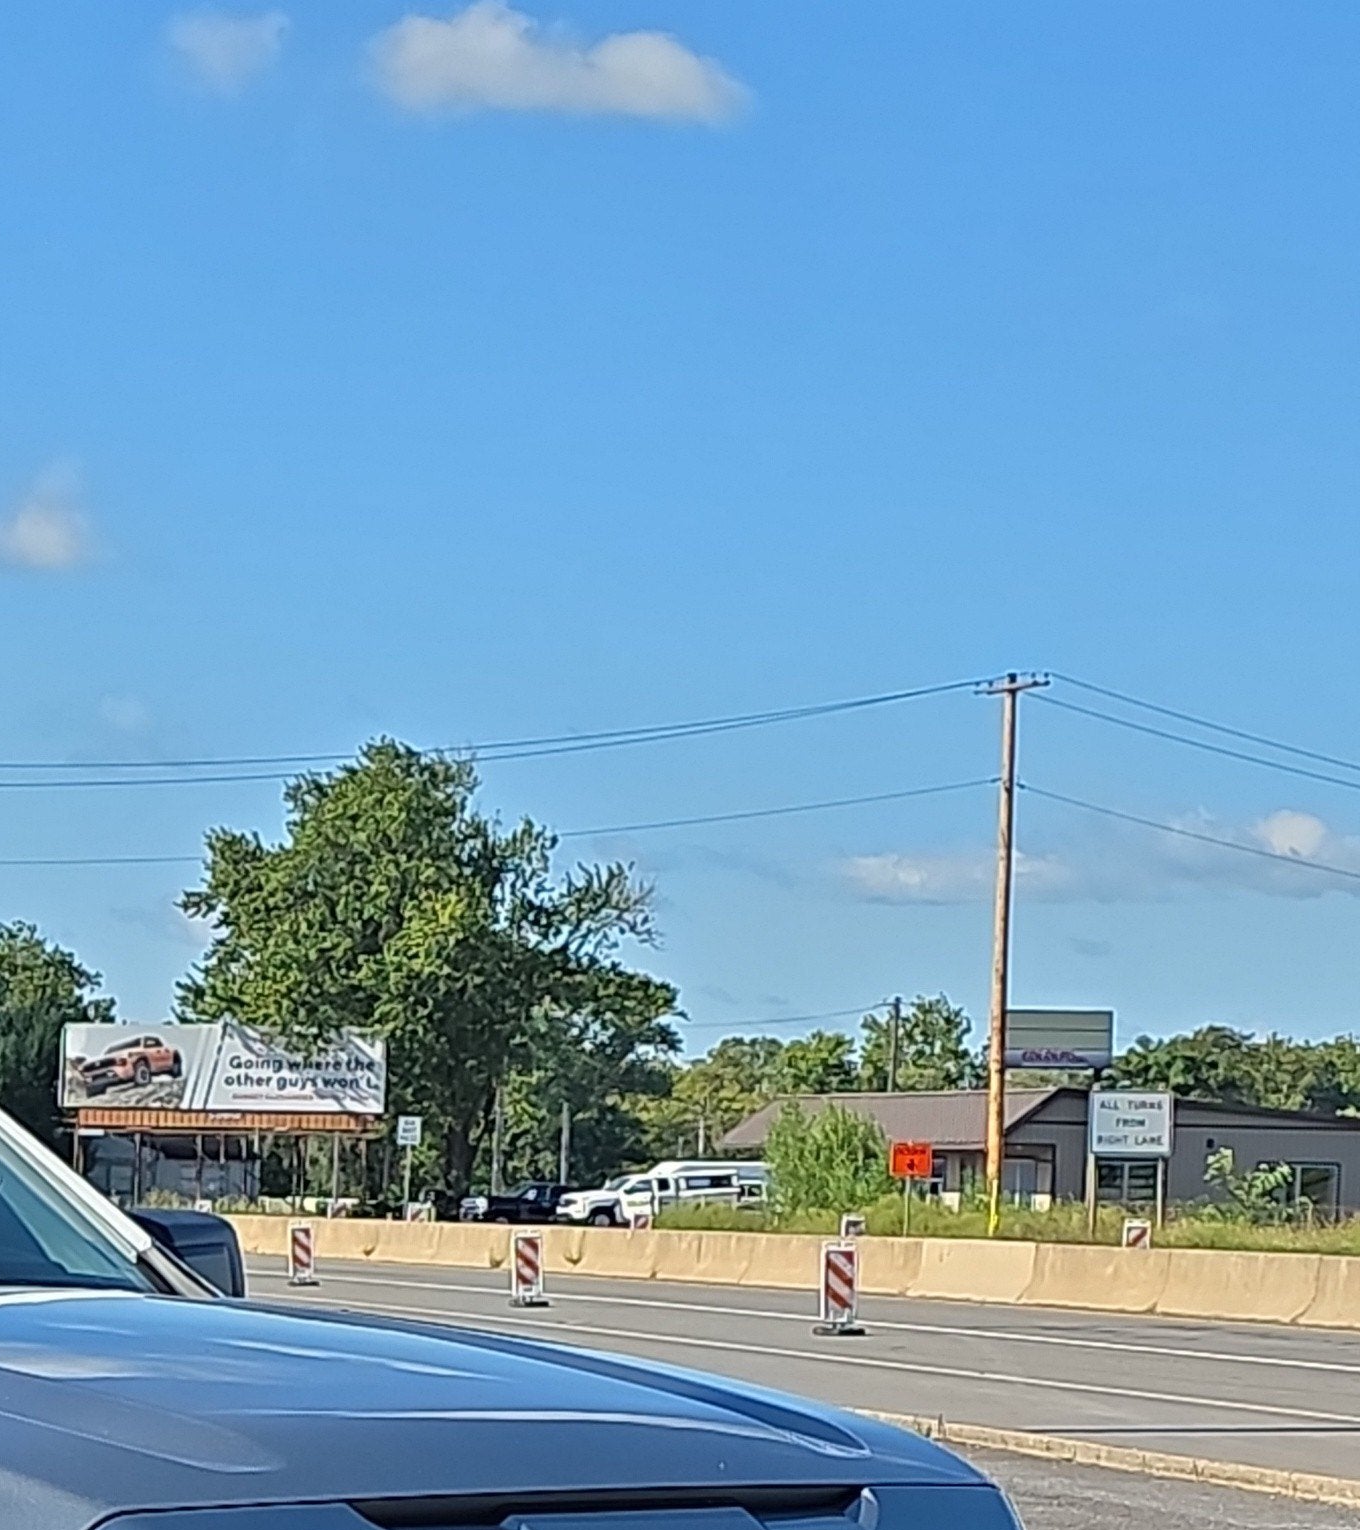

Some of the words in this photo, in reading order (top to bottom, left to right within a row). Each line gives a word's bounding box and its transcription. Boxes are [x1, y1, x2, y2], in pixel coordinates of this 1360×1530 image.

[229, 1055, 283, 1073] Going
[286, 1056, 342, 1071] where
[346, 1056, 376, 1071] the
[224, 1073, 272, 1088] other
[276, 1076, 318, 1091] guys
[1099, 1100, 1119, 1110] ALL
[1127, 1100, 1164, 1111] TURNS
[1115, 1118, 1146, 1127] FROM
[1134, 1135, 1164, 1146] LANE
